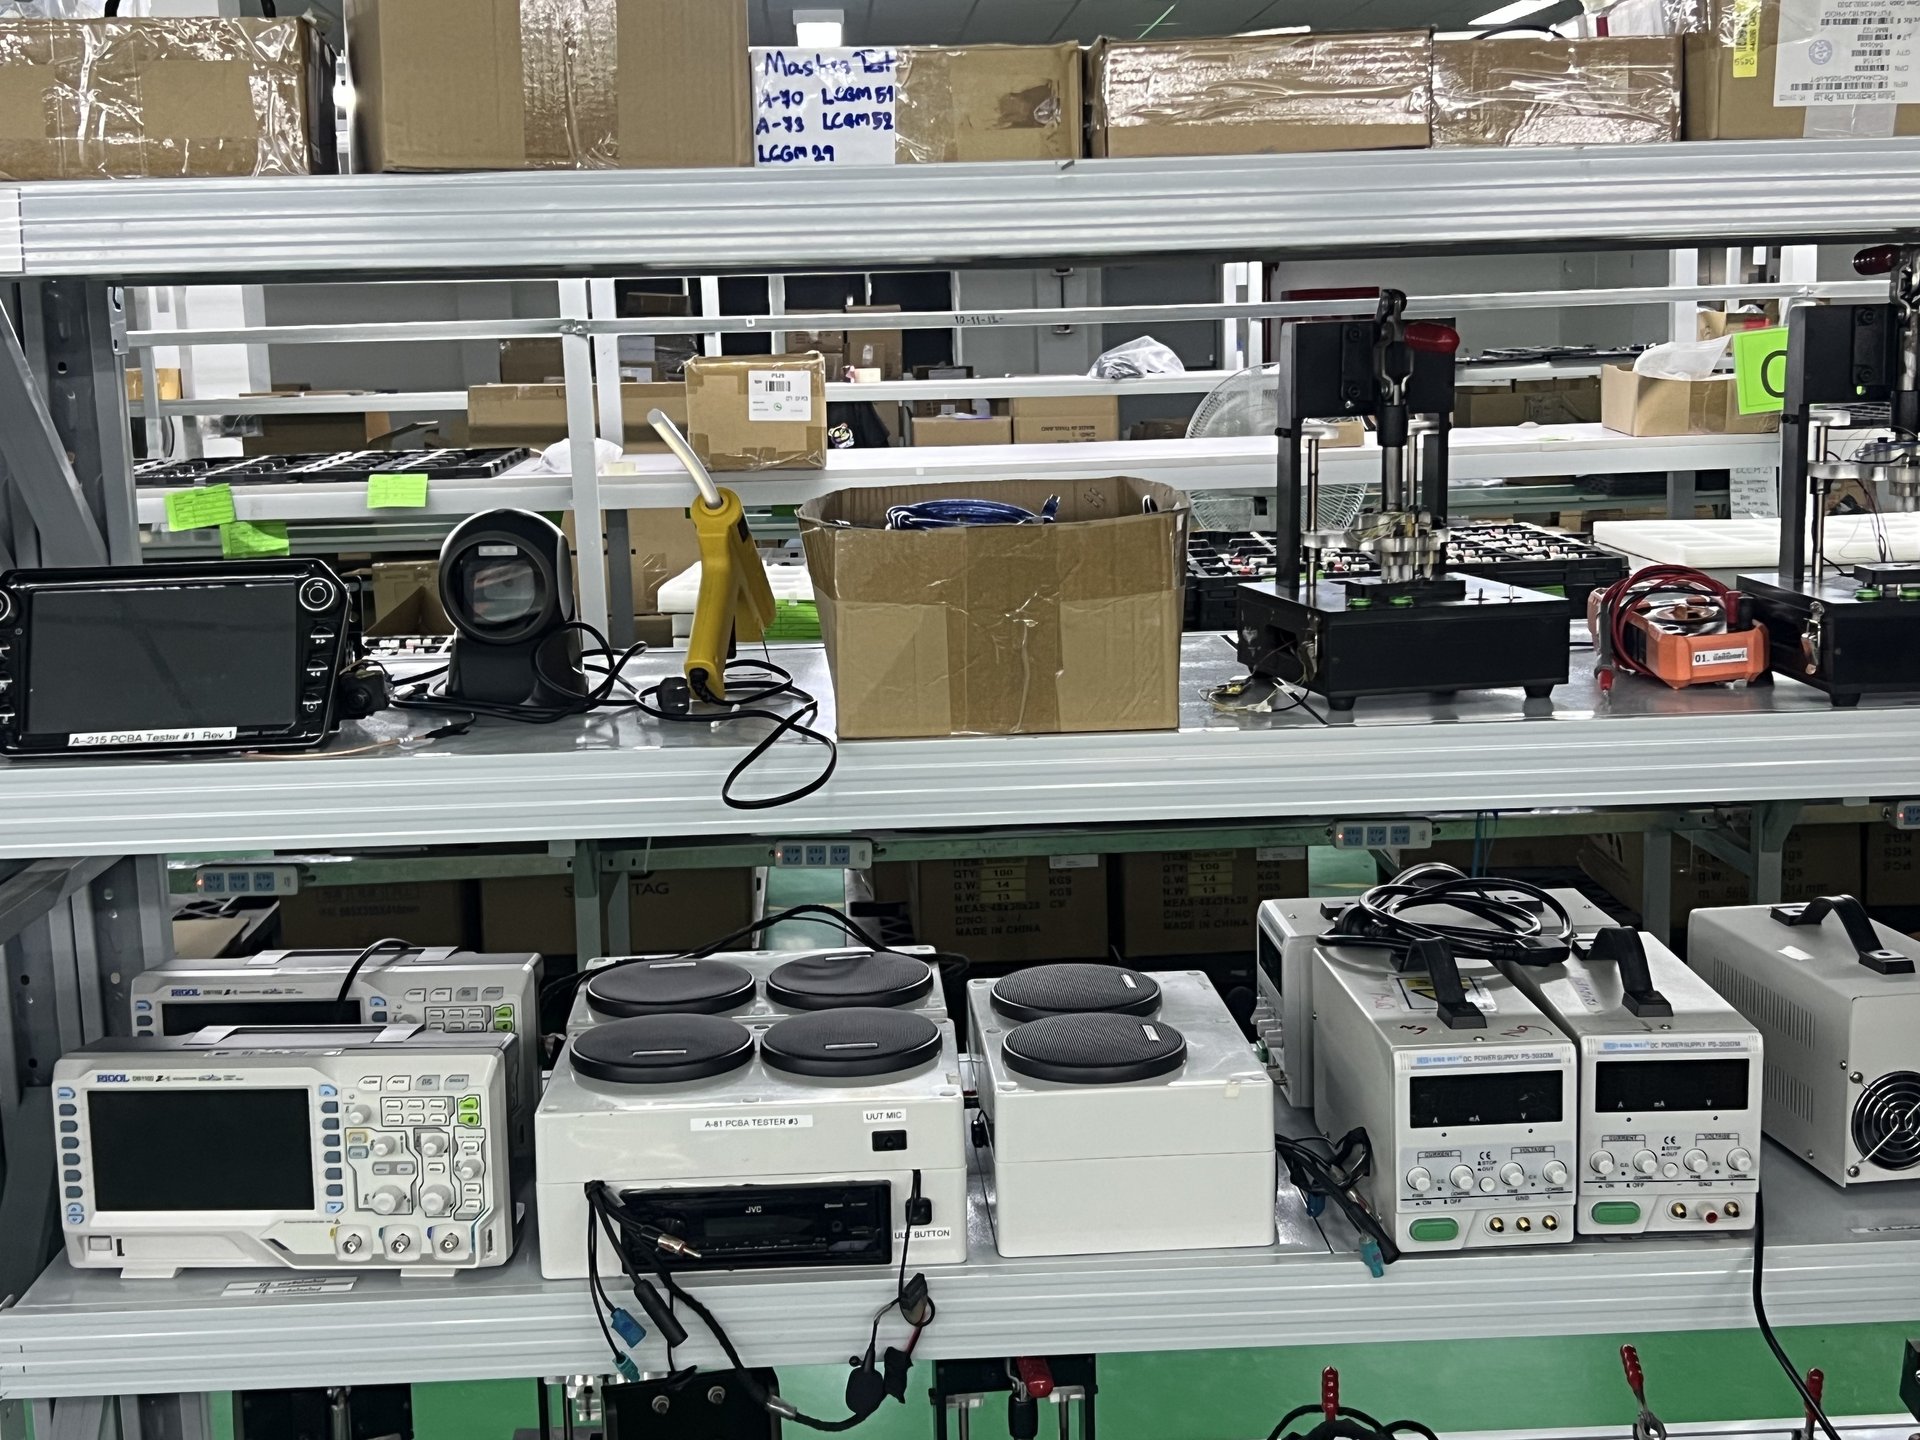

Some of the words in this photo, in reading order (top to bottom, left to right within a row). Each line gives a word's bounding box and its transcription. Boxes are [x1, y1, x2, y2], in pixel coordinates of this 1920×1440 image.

[72, 735, 107, 745] A-215
[110, 734, 142, 743] PCBA
[146, 732, 180, 742] Tester
[202, 731, 225, 739] Rev
[956, 927, 987, 936] MADE
[992, 926, 1003, 935] IN
[1006, 924, 1040, 933] CHINA
[705, 1120, 723, 1128] A-81
[725, 1119, 750, 1127] PCBA
[752, 1118, 786, 1126] TESTER
[746, 1205, 762, 1213] JVC
[914, 1230, 950, 1238] BUTTON
